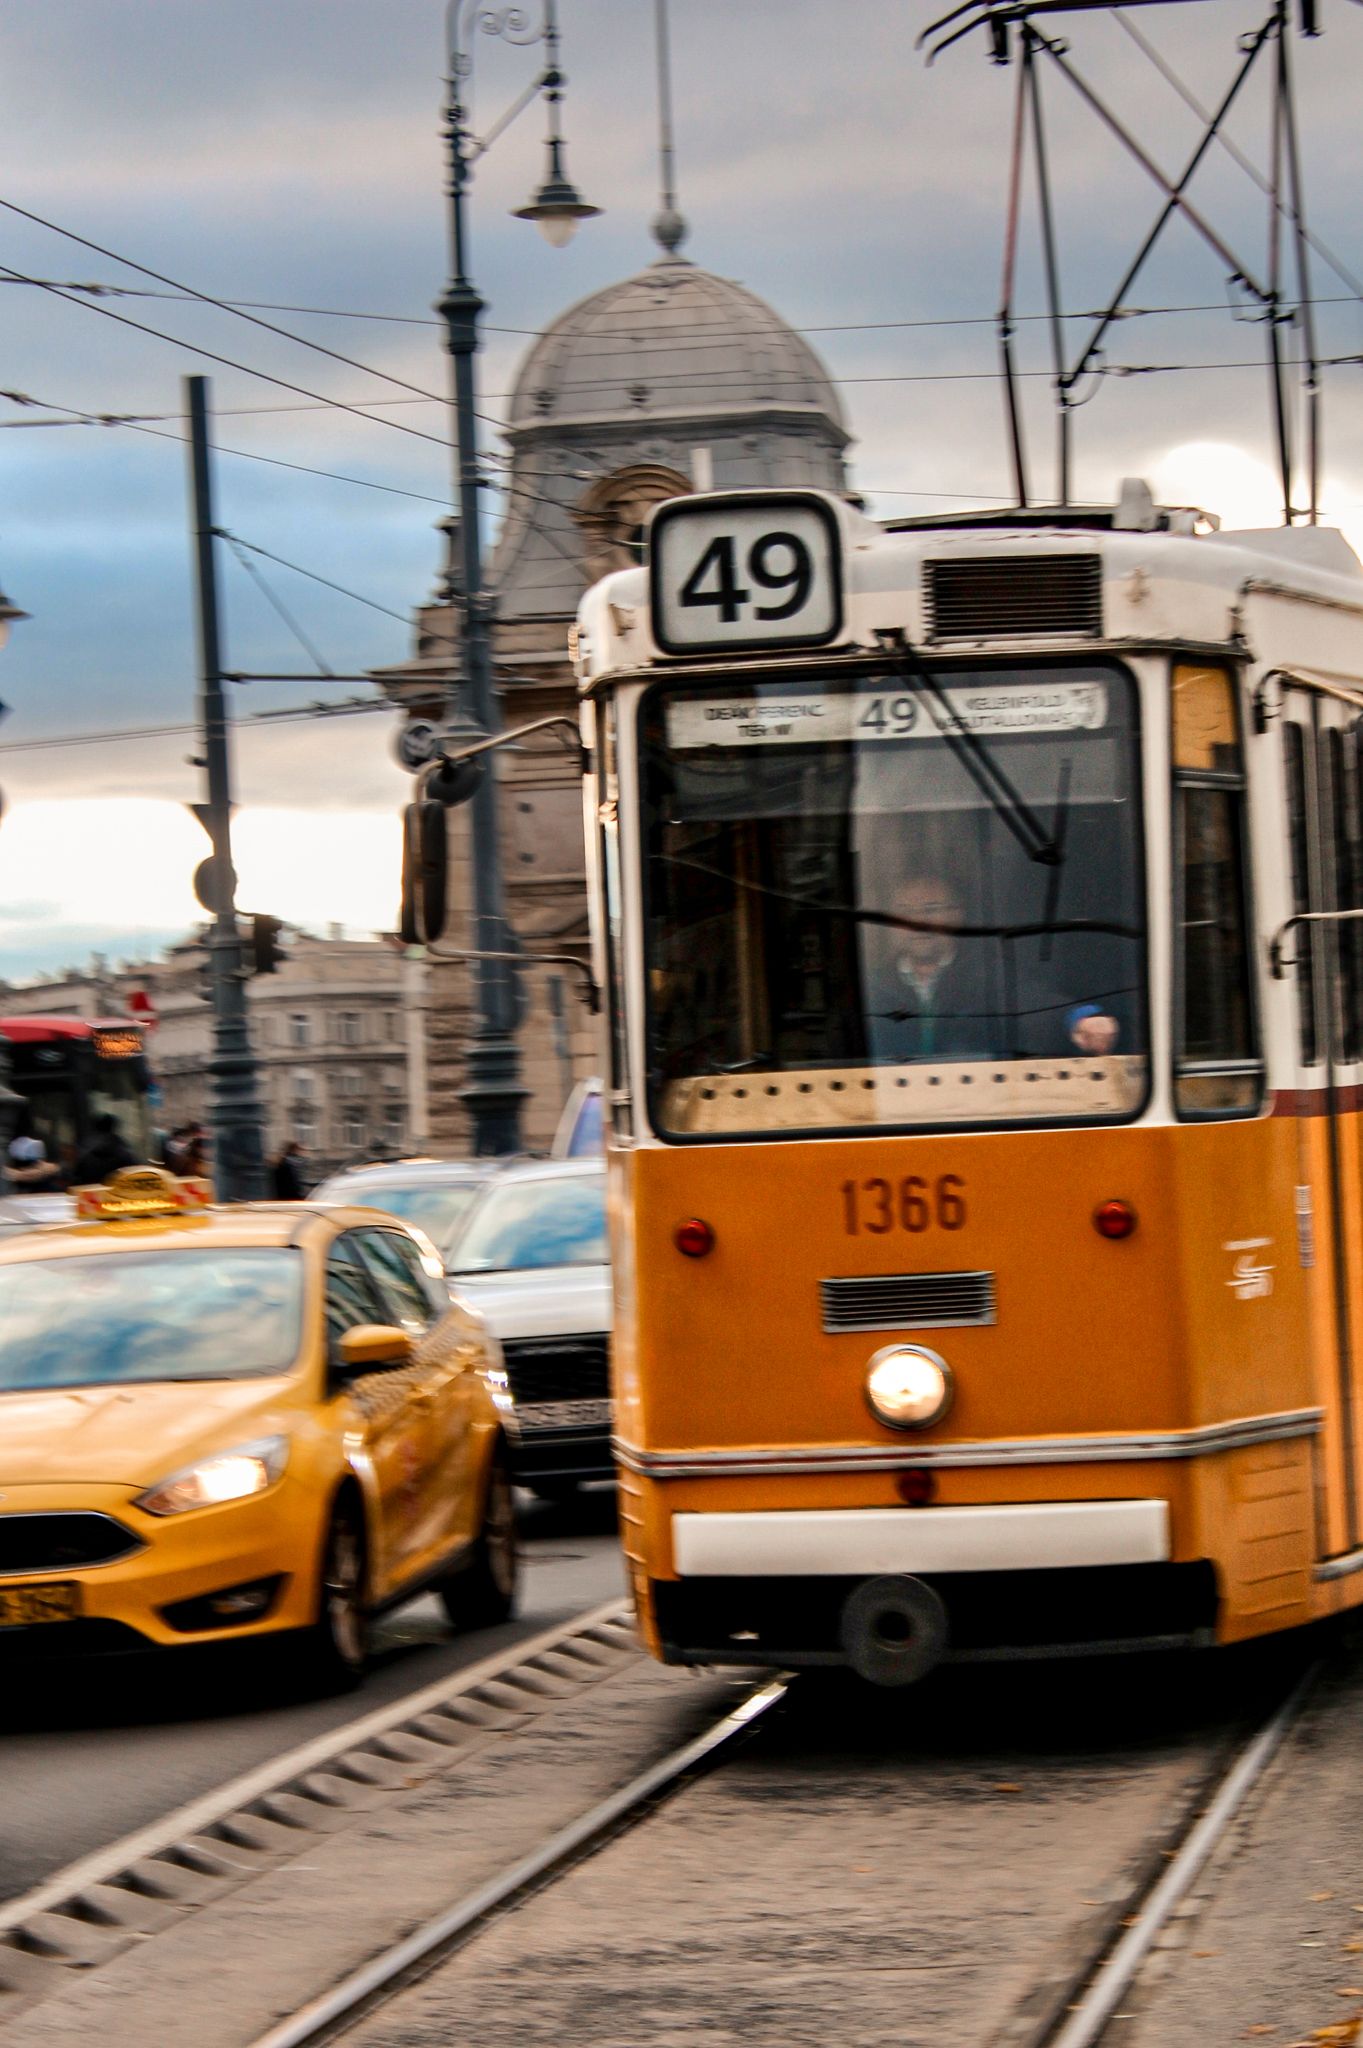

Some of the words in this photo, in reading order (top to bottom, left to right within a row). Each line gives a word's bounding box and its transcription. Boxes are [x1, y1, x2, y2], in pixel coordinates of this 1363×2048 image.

[678, 532, 812, 622] 49
[858, 697, 917, 735] 49
[841, 1174, 967, 1236] 1366
